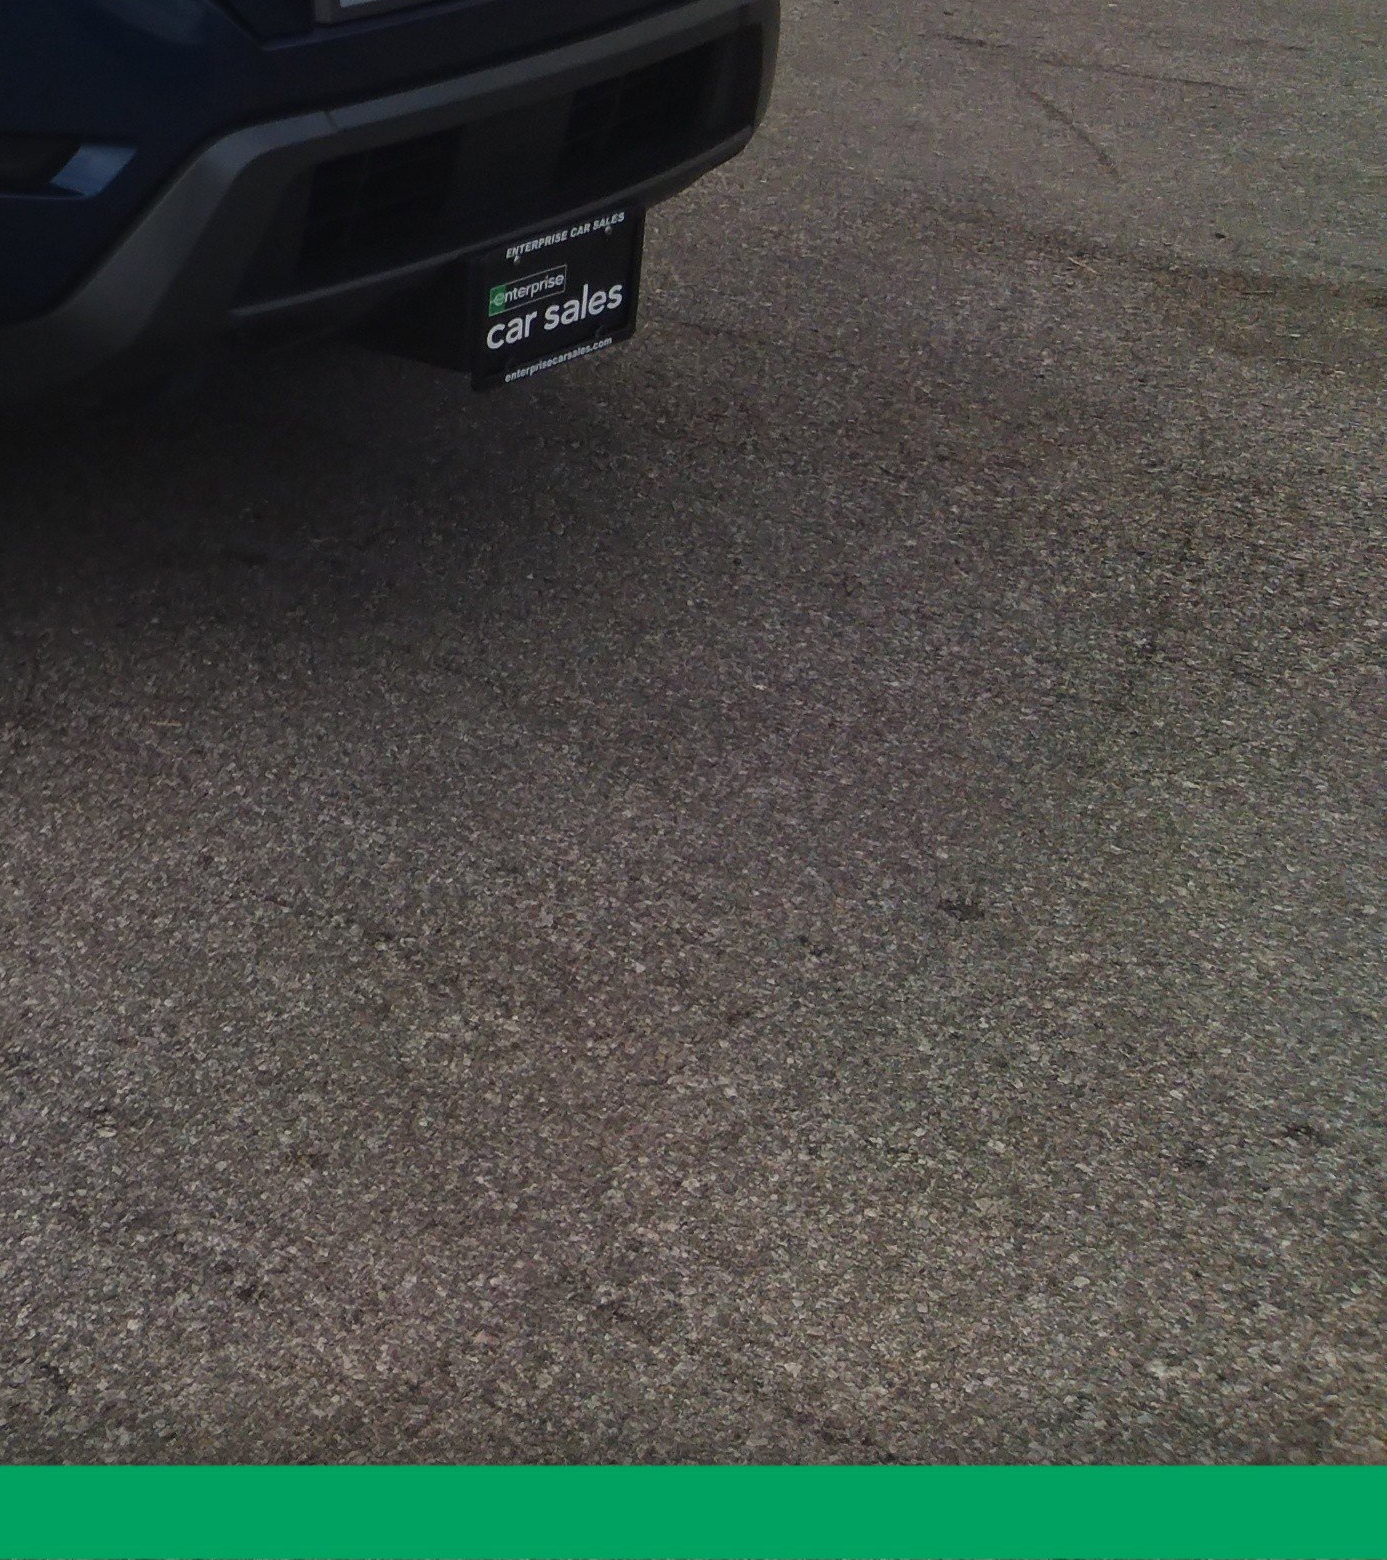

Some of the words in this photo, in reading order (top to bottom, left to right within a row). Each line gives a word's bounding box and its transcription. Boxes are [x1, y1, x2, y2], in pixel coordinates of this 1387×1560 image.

[505, 230, 568, 259] ENTERPRISE
[570, 221, 591, 238] CAR
[592, 211, 625, 231] SALES
[493, 273, 565, 306] enterprise
[486, 310, 538, 349] car
[543, 283, 623, 331] sales
[504, 336, 613, 383] enterprisecarsales.com
